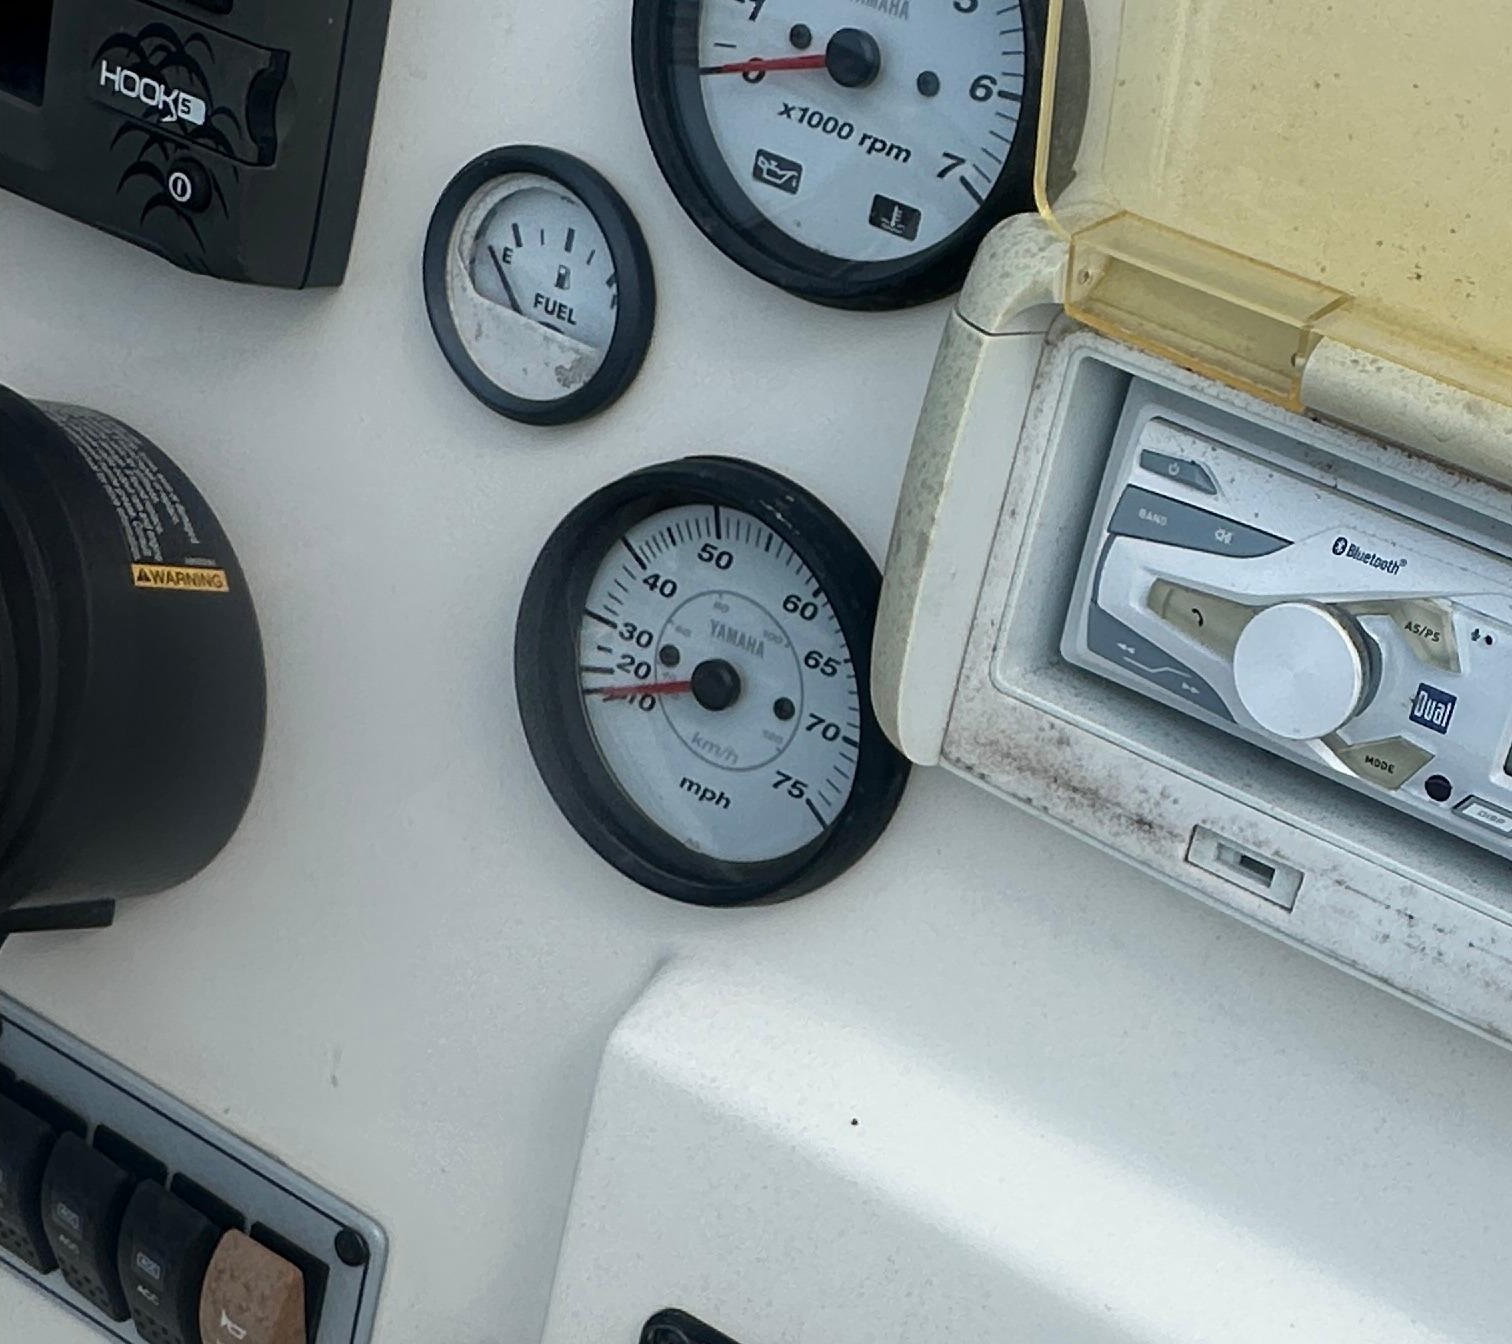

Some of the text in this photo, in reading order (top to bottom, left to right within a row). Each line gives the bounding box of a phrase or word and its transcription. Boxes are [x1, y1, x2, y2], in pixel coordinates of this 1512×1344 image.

[968, 74, 999, 103] 6
[777, 102, 912, 164] x1000 rpm
[935, 151, 966, 180] 7
[502, 246, 514, 265] E
[533, 292, 578, 326] FUEL
[697, 542, 734, 571] 50
[148, 570, 224, 589] WARNING
[642, 572, 678, 600] 40
[782, 593, 819, 623] 60
[617, 621, 654, 649] 30
[710, 618, 766, 659] YAMAHA
[1404, 620, 1441, 643] AS/PS
[616, 653, 652, 680] 20
[803, 649, 839, 679] 65
[1413, 690, 1452, 728] Dual
[803, 712, 842, 743] 70
[691, 731, 739, 765] km/h
[1364, 755, 1396, 774] MODE
[679, 774, 732, 811] mph
[771, 771, 809, 799] 75
